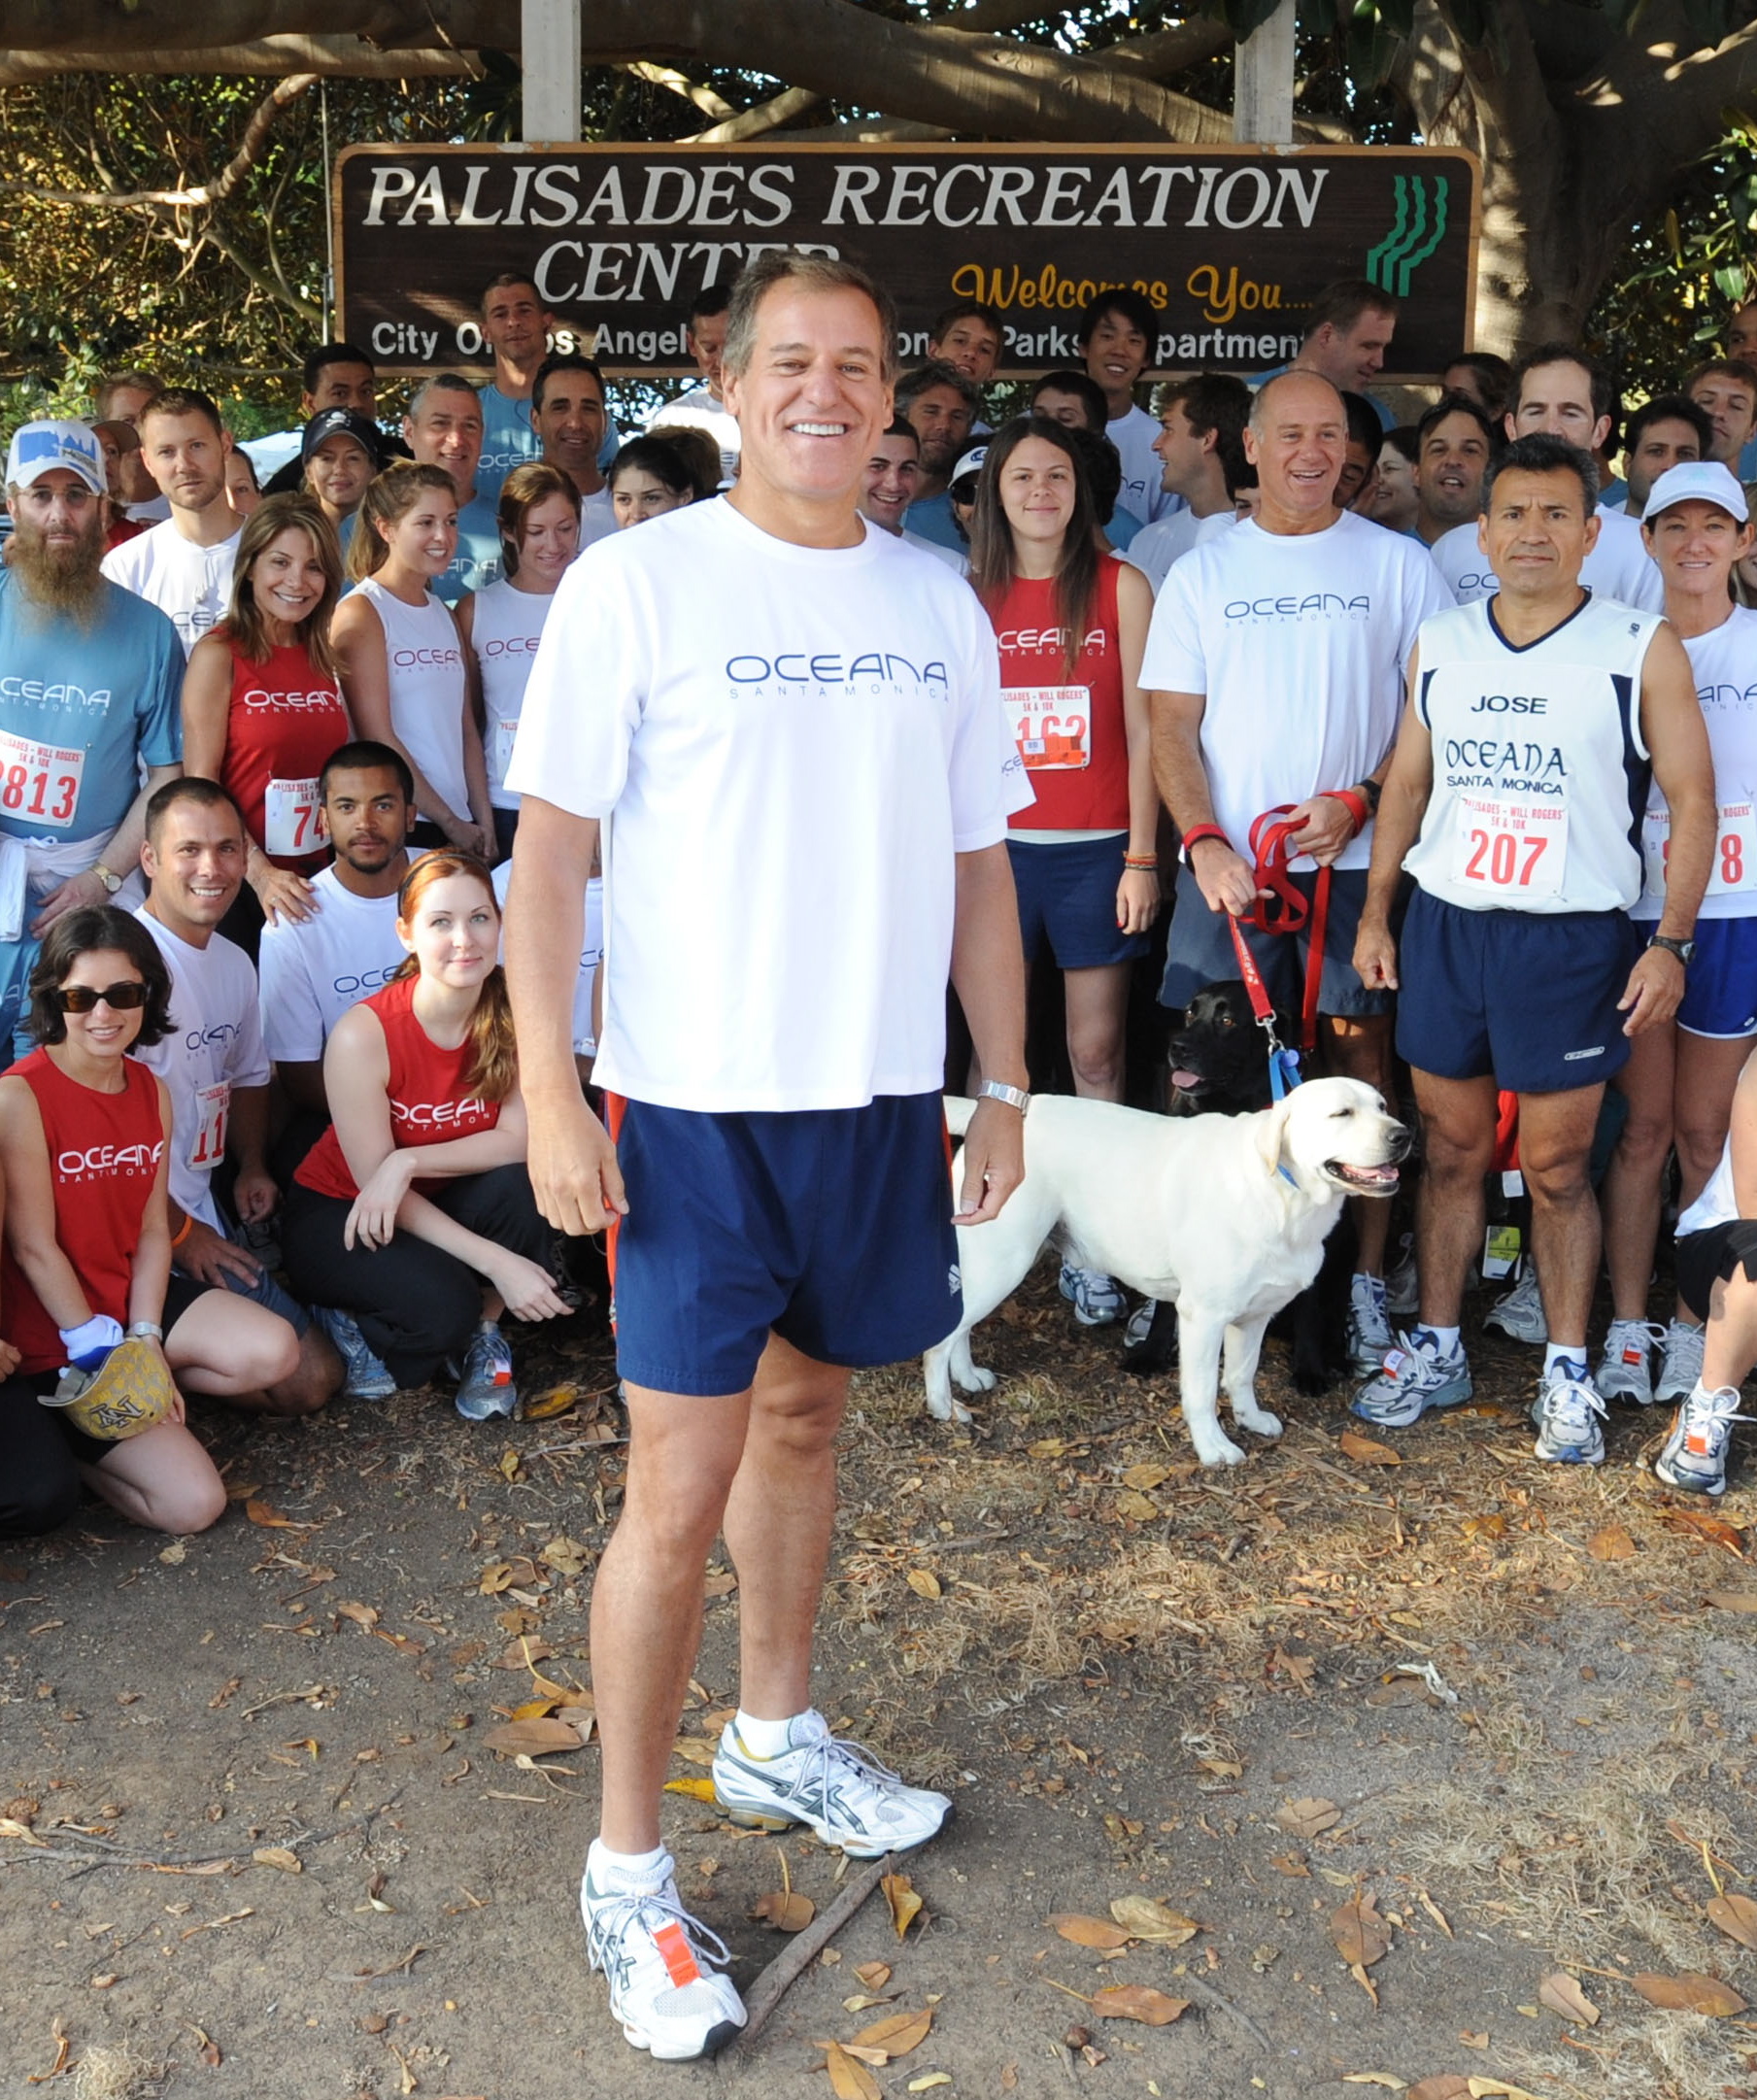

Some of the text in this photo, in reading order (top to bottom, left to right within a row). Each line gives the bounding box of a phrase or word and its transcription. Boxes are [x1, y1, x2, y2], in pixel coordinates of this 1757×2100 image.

[362, 163, 1330, 229] PALISADES RECREATION
[534, 239, 839, 303] CENT
[372, 322, 439, 361] City
[456, 322, 492, 356] O
[593, 322, 687, 362] Angel
[1155, 328, 1305, 366] partmen
[1223, 593, 1370, 620] OCEANA
[485, 637, 540, 656] OCE
[726, 653, 949, 689] OCEANA
[0, 677, 111, 709] CEANA
[1470, 694, 1549, 715] JOSE
[1696, 683, 1757, 701] ANA
[1446, 739, 1569, 779] OCEANA
[0, 760, 77, 820] 813
[1446, 774, 1564, 796] SANTA MONICA
[1510, 806, 1529, 819] WILL
[1465, 828, 1548, 886] 207
[334, 965, 400, 994] OCE
